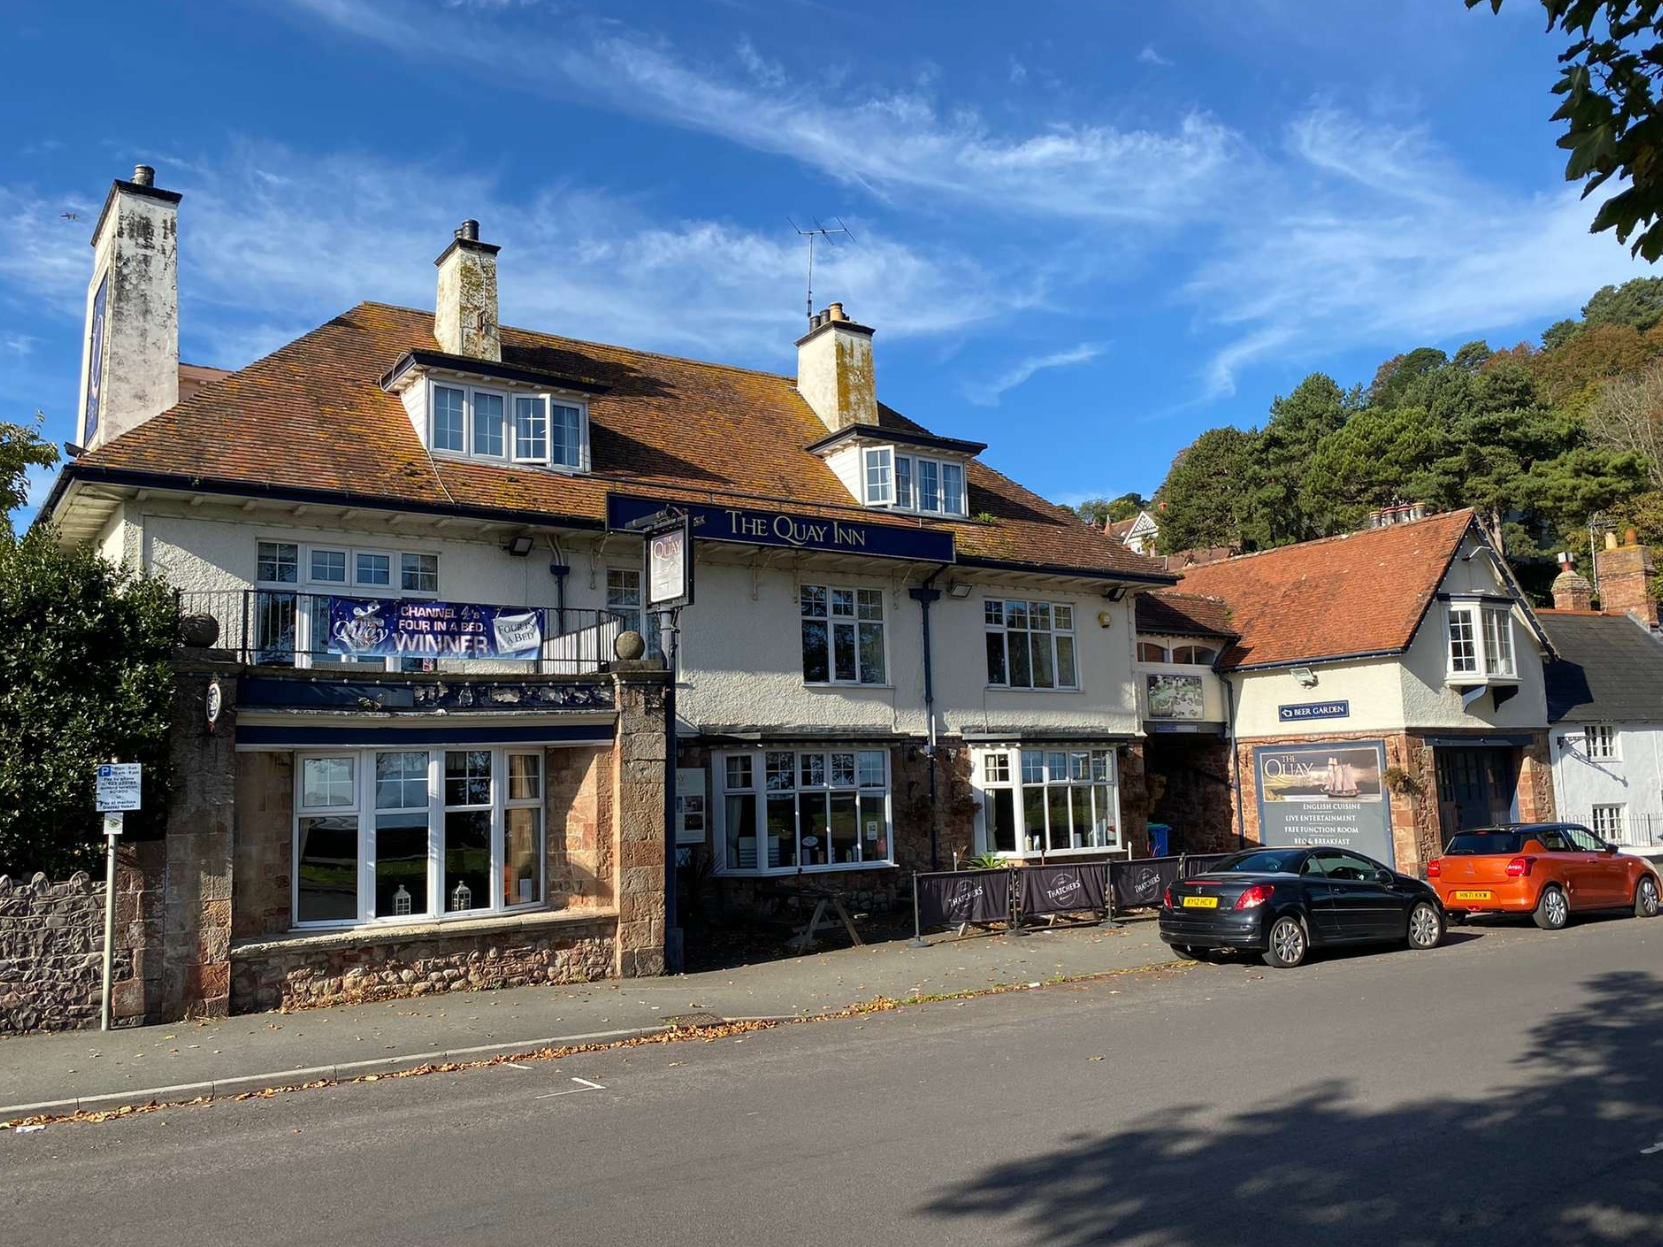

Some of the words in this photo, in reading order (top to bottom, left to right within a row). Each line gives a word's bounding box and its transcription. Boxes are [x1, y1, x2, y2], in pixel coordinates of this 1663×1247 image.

[725, 509, 768, 536] THE
[773, 515, 827, 546] QUAY
[833, 521, 865, 546] INN
[654, 541, 681, 561] QUAY
[401, 605, 457, 619] CHANNEL
[399, 619, 431, 632] FOUR
[433, 621, 447, 632] IN
[449, 621, 458, 632] A
[498, 623, 524, 635] FOUR
[392, 630, 488, 654] WINNER
[506, 636, 514, 644] A
[514, 631, 535, 643] BED
[1293, 708, 1312, 717] BEER
[1312, 705, 1344, 716] GARDEN
[1282, 755, 1297, 763] THE
[1264, 758, 1314, 784] QUAY
[1047, 880, 1080, 899] THATCHERS
[1134, 874, 1160, 893] THATCHERS
